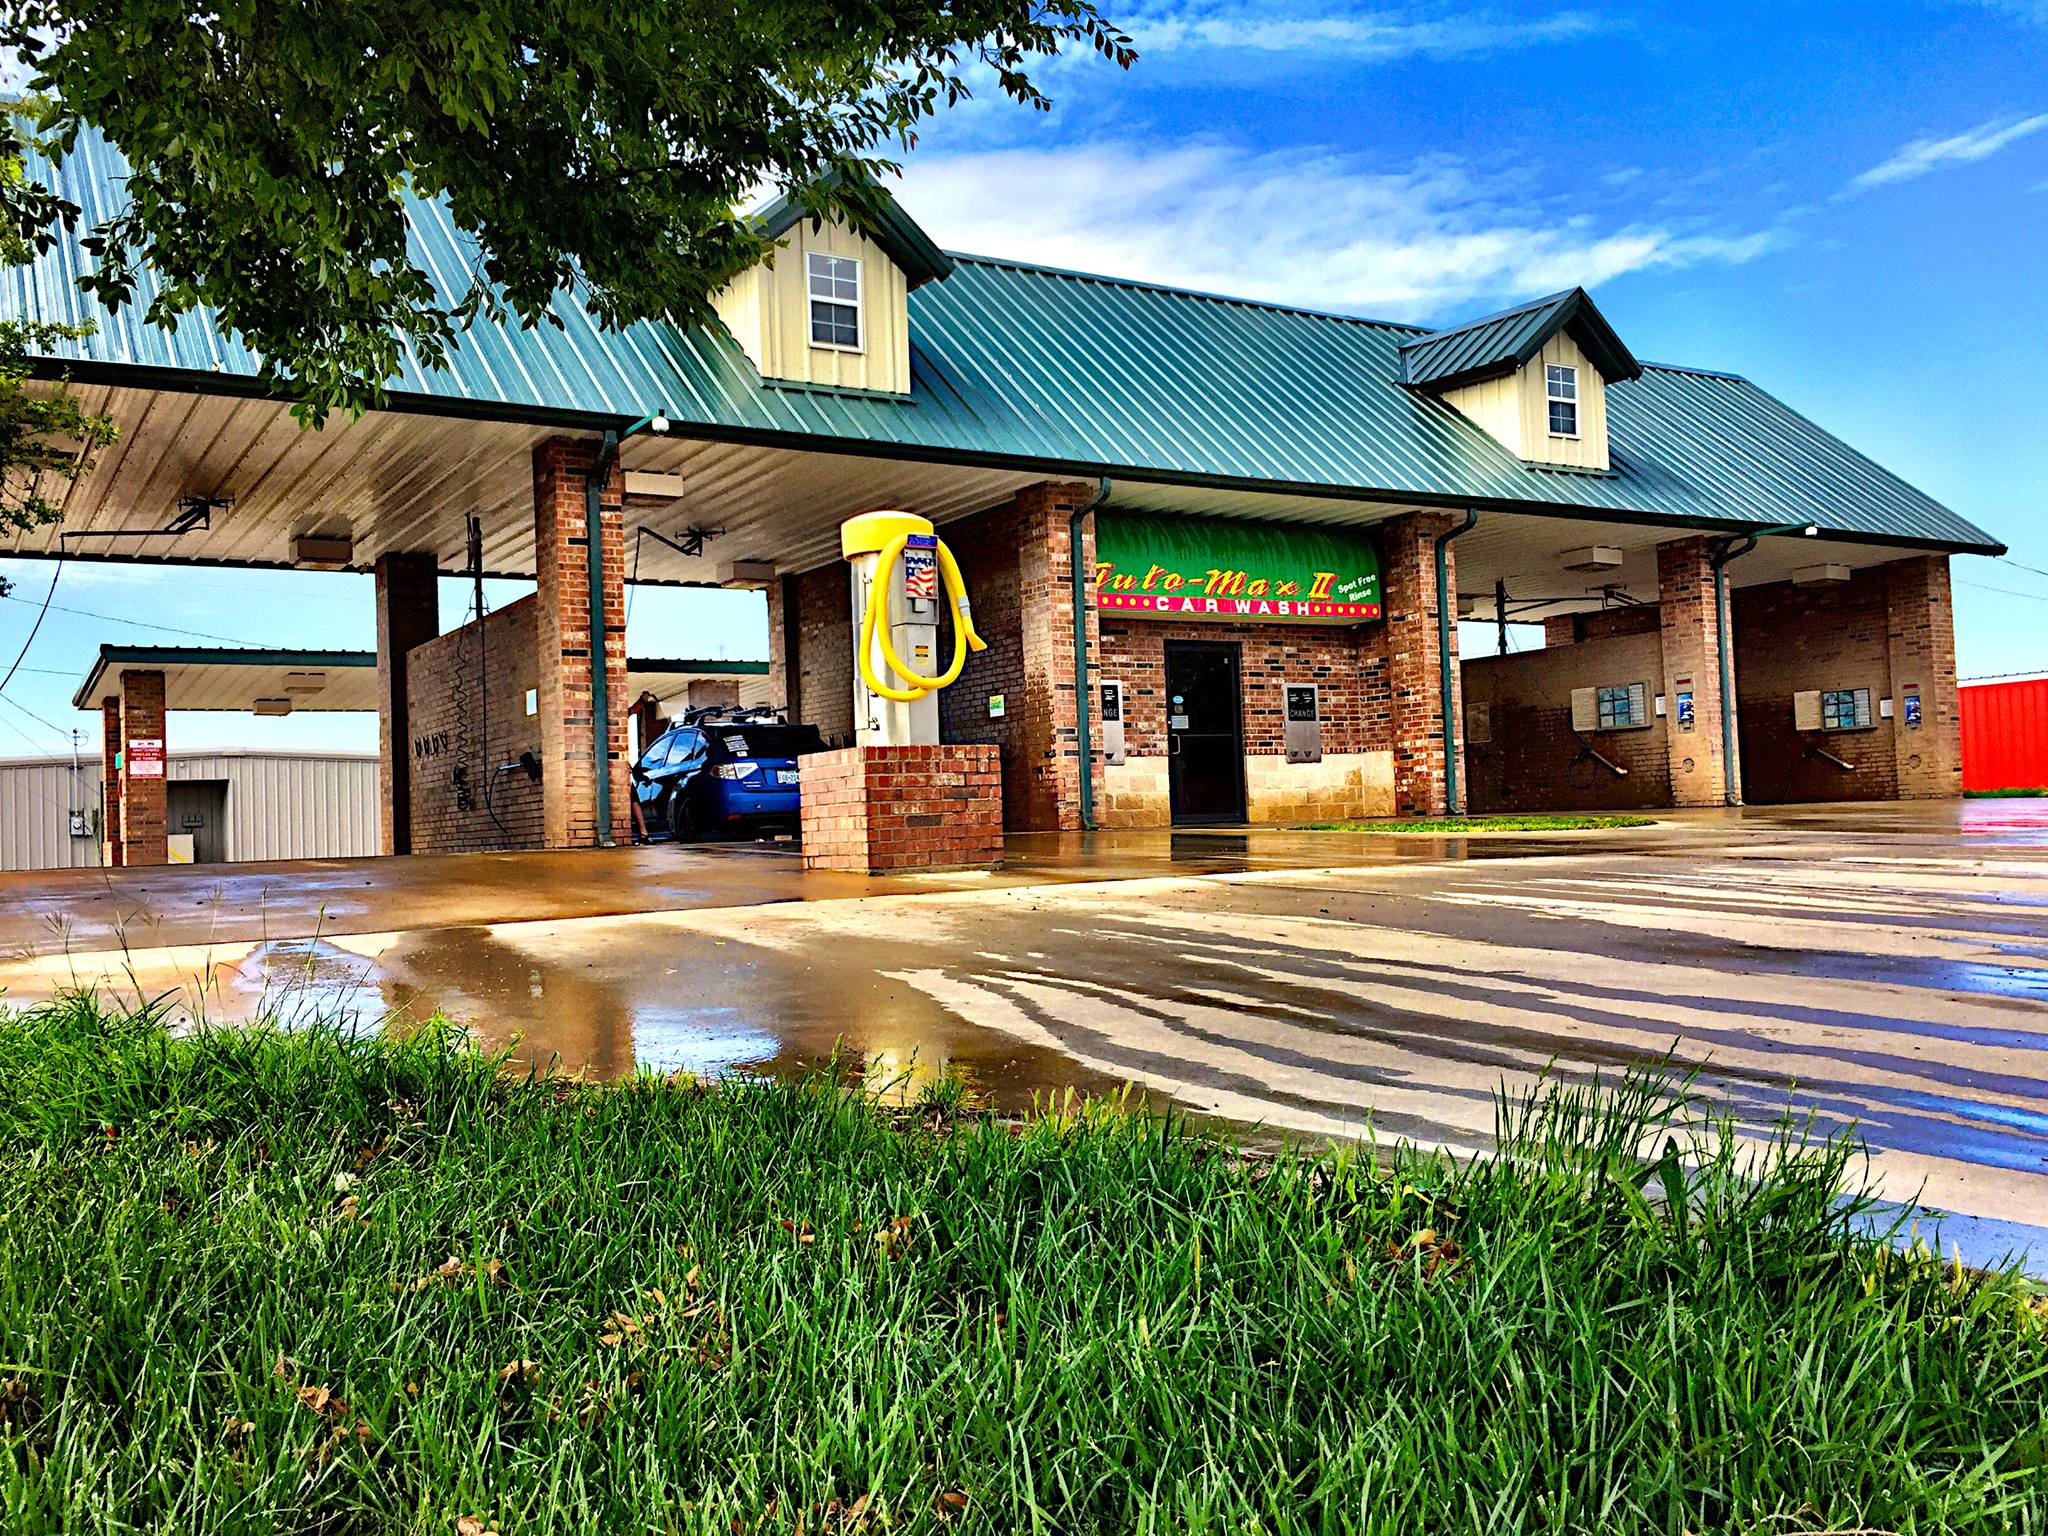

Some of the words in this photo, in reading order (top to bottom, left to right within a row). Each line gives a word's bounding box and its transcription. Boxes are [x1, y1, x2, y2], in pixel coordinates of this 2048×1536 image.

[1307, 572, 1339, 600] II
[1338, 580, 1357, 594] Spot
[1357, 574, 1376, 586] Free
[1349, 588, 1372, 602] Rinse
[1156, 596, 1218, 613] CAR
[1235, 599, 1310, 616] WASH
[1103, 708, 1118, 717] NGE
[1290, 709, 1314, 718] CHANGE
